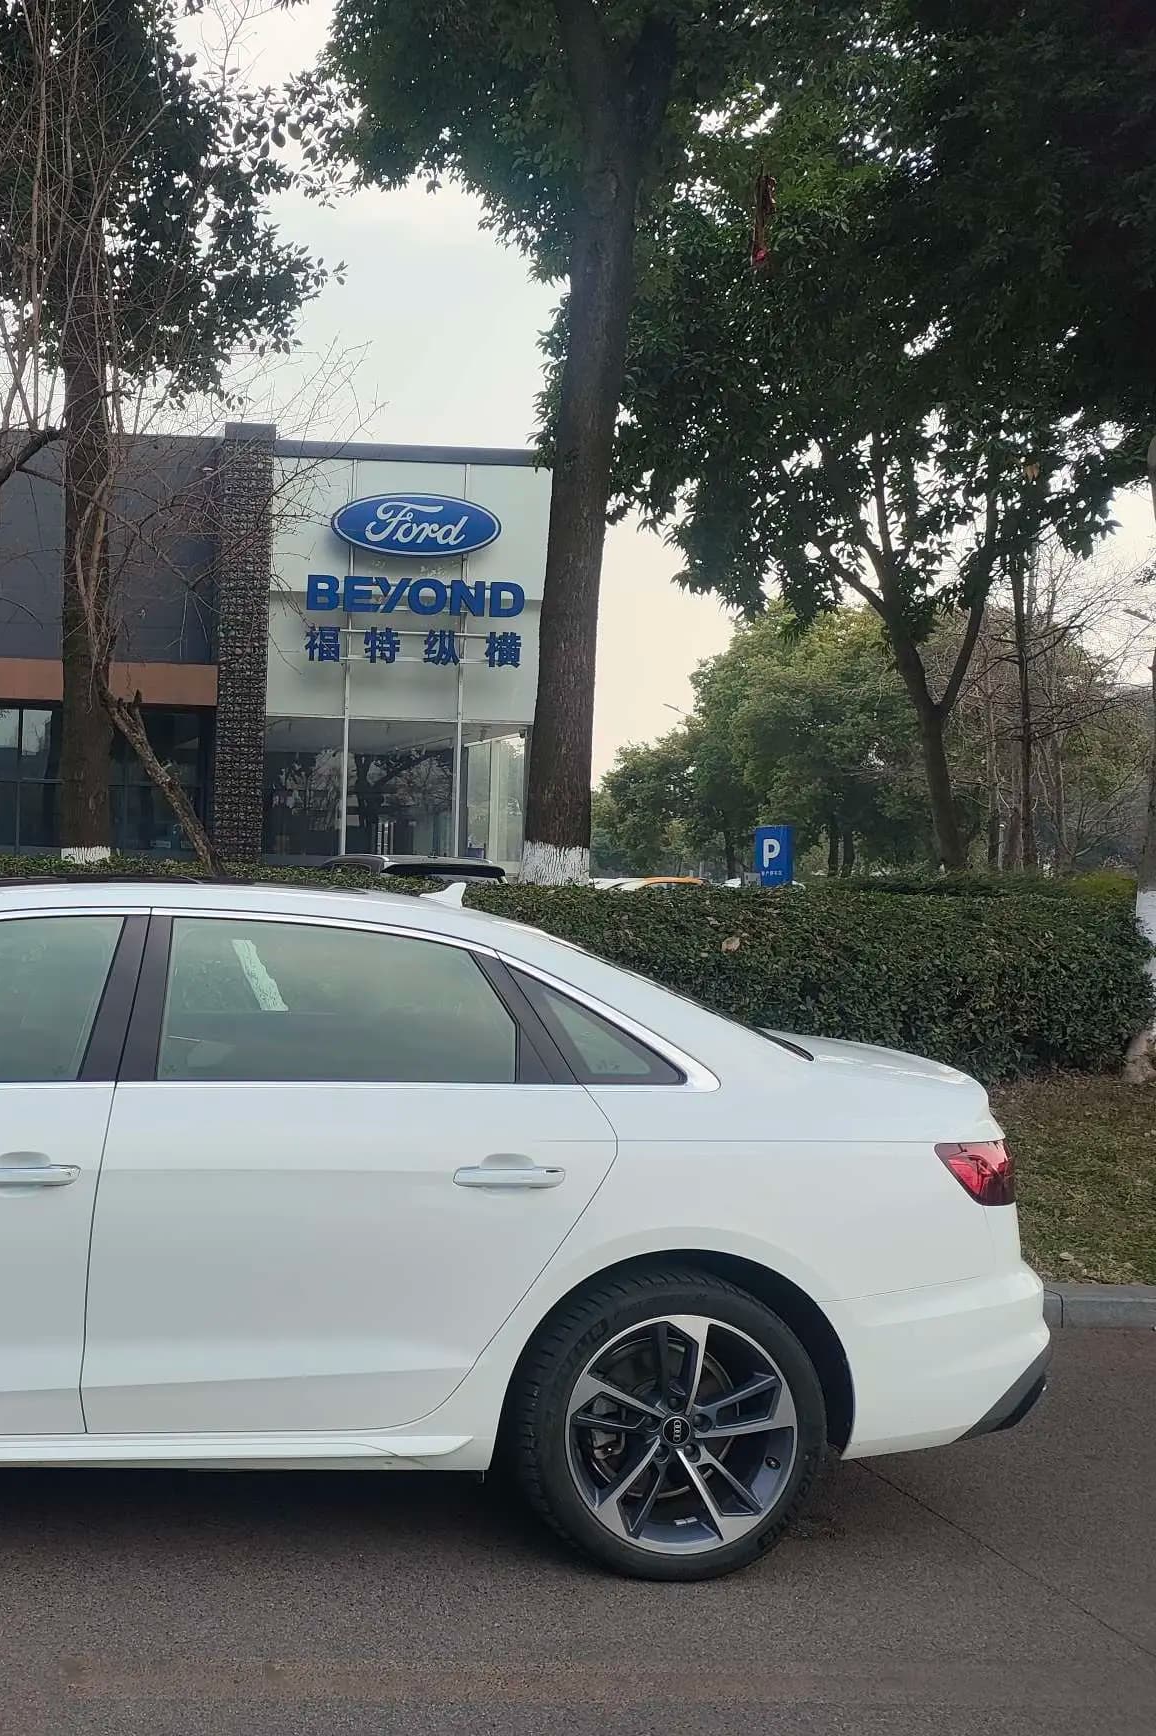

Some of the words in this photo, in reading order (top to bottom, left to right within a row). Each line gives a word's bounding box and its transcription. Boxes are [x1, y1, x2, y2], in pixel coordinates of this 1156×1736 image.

[365, 501, 469, 545] Ford
[306, 574, 526, 618] BEYOND
[305, 625, 522, 668] 福特纵横
[763, 838, 781, 868] P
